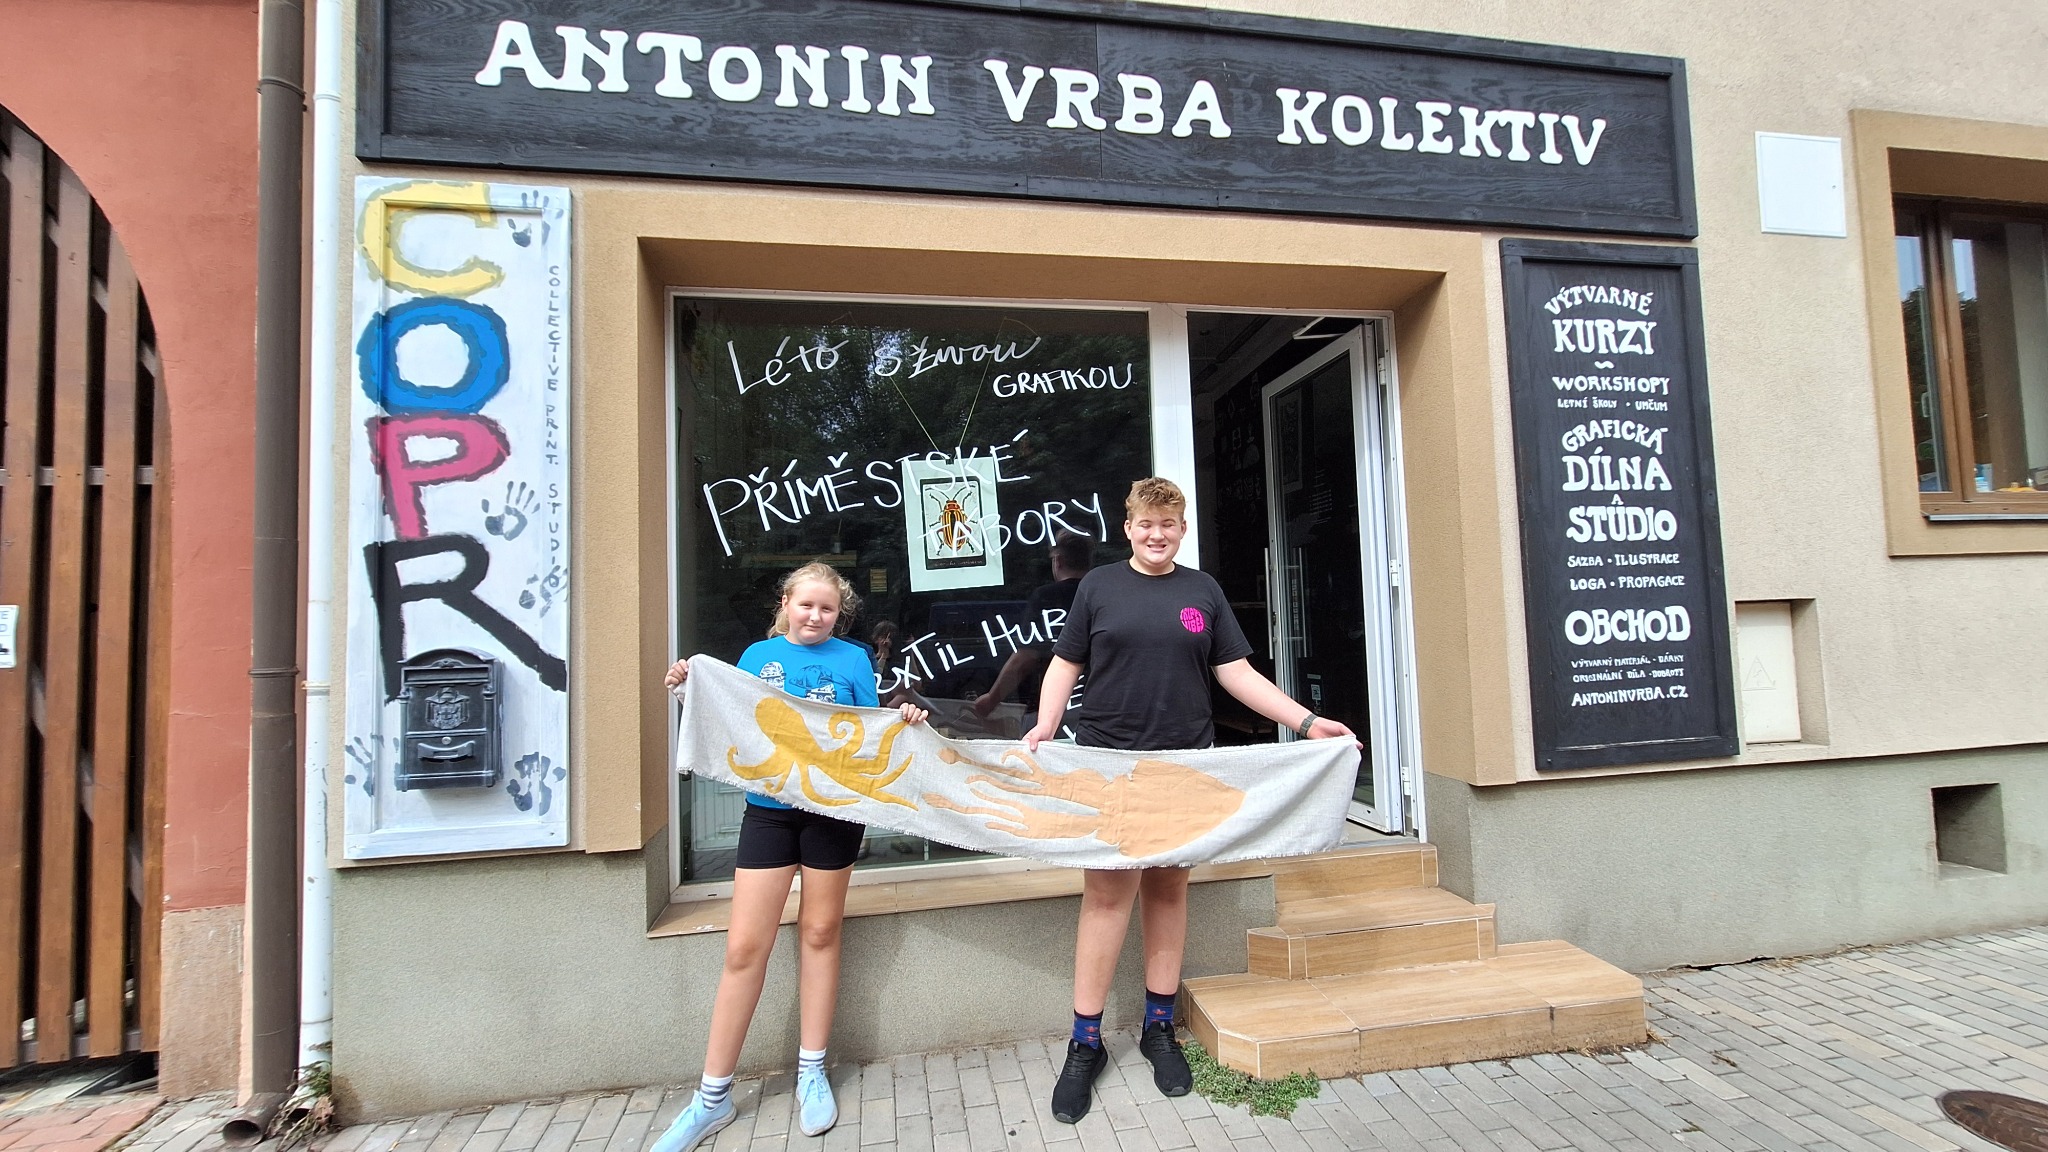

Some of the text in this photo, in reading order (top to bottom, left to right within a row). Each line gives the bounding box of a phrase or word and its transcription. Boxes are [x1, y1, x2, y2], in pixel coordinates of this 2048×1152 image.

[475, 19, 1607, 167] ANTONIN VRBA KOLEKTIV
[1544, 285, 1654, 316] VÝTVARNÉ
[546, 264, 562, 391] COLLECTIVE
[1552, 318, 1658, 355] KURZY
[727, 335, 851, 396] Léto
[1551, 374, 1670, 395] WORKSHOPY
[1557, 396, 1588, 409] LETNÍ
[1591, 396, 1618, 409] ŠKOLY
[355, 179, 567, 706] COPR
[1561, 419, 1669, 454] GRAFICKÁ
[1561, 445, 1673, 492] DÍLNA
[702, 428, 1032, 557] PŘÍMĚSTSKÉ
[546, 482, 562, 589] STUDIO
[1566, 505, 1679, 543] STUDIO
[1567, 553, 1680, 568] SAZBA ILUSTRACE
[1569, 575, 1686, 591] LOGA PROPAGACE
[1564, 604, 1692, 645] OBCHOD
[1571, 656, 1613, 669] VÝTVARNÝ
[1626, 668, 1646, 679] DÍLA
